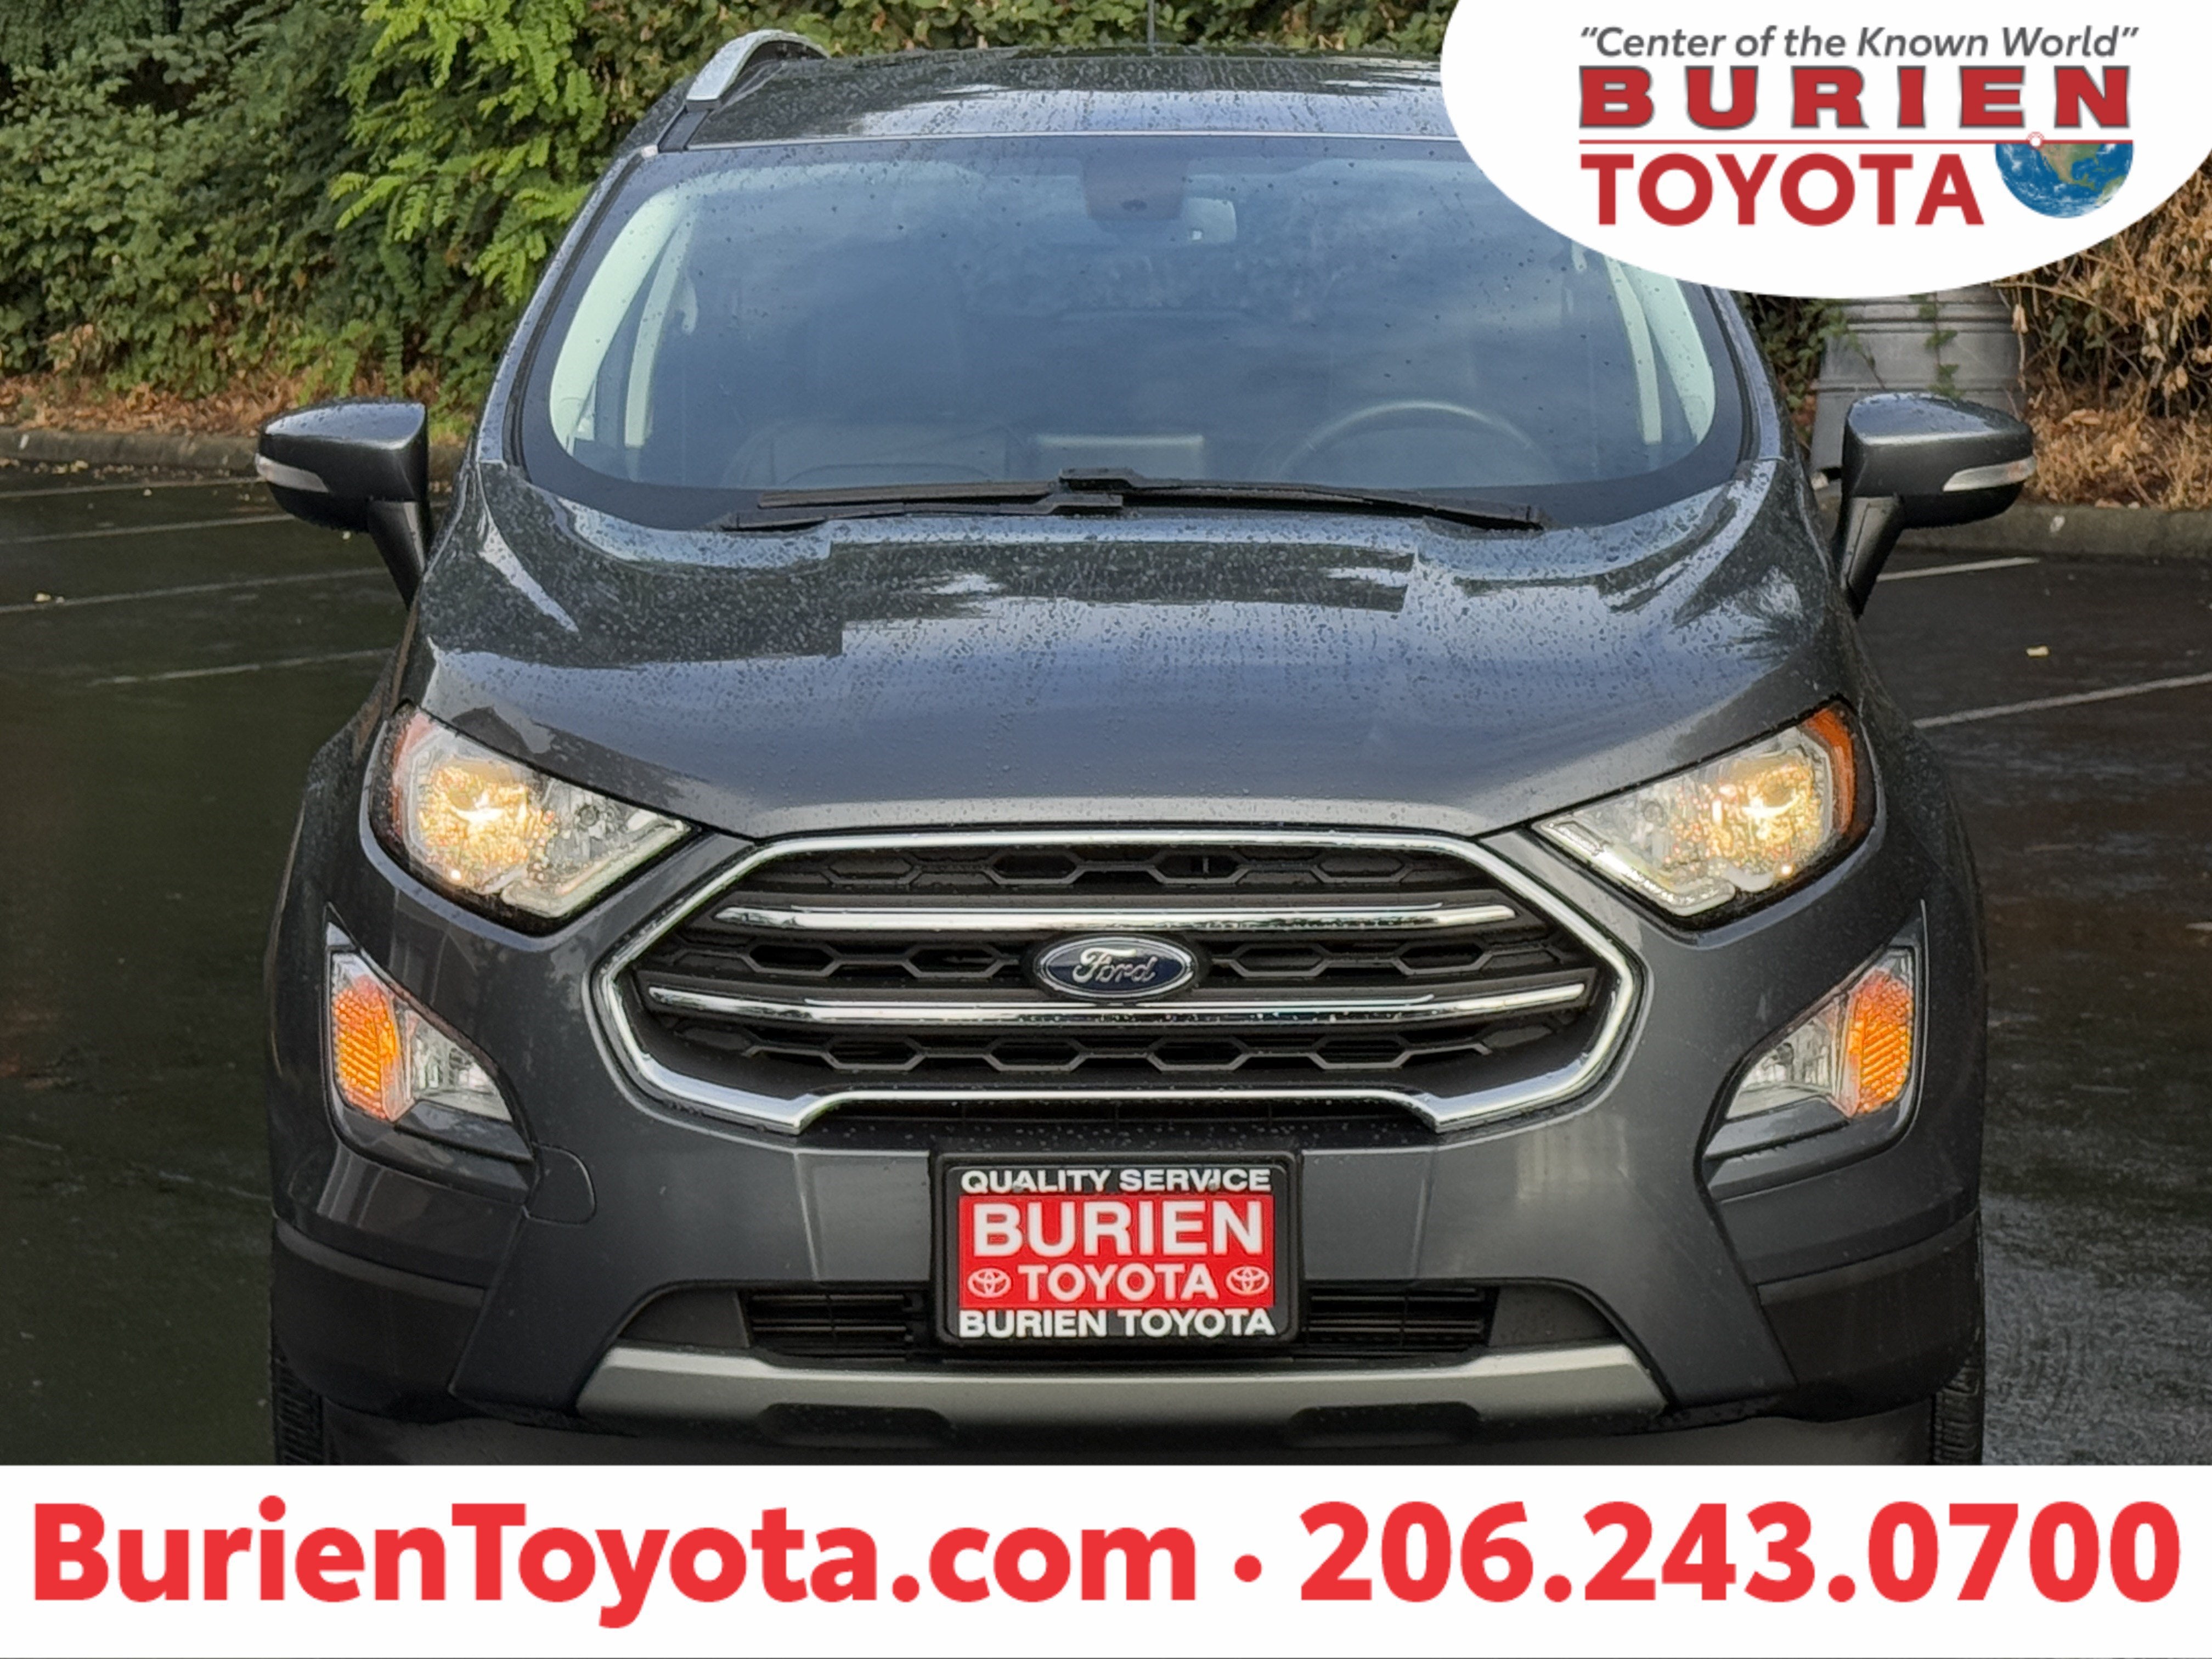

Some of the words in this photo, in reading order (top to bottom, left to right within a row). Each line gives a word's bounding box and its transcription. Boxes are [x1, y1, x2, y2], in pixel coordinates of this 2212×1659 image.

[1073, 947, 1158, 983] Ford
[961, 1170, 1111, 1193] QUALITY
[1120, 1169, 1271, 1190] SERVICE
[973, 1200, 1263, 1257] BURIEN
[1018, 1263, 1218, 1302] TOYOTA
[960, 1309, 1108, 1338] BURIEN
[1116, 1308, 1275, 1336] TOYOTA
